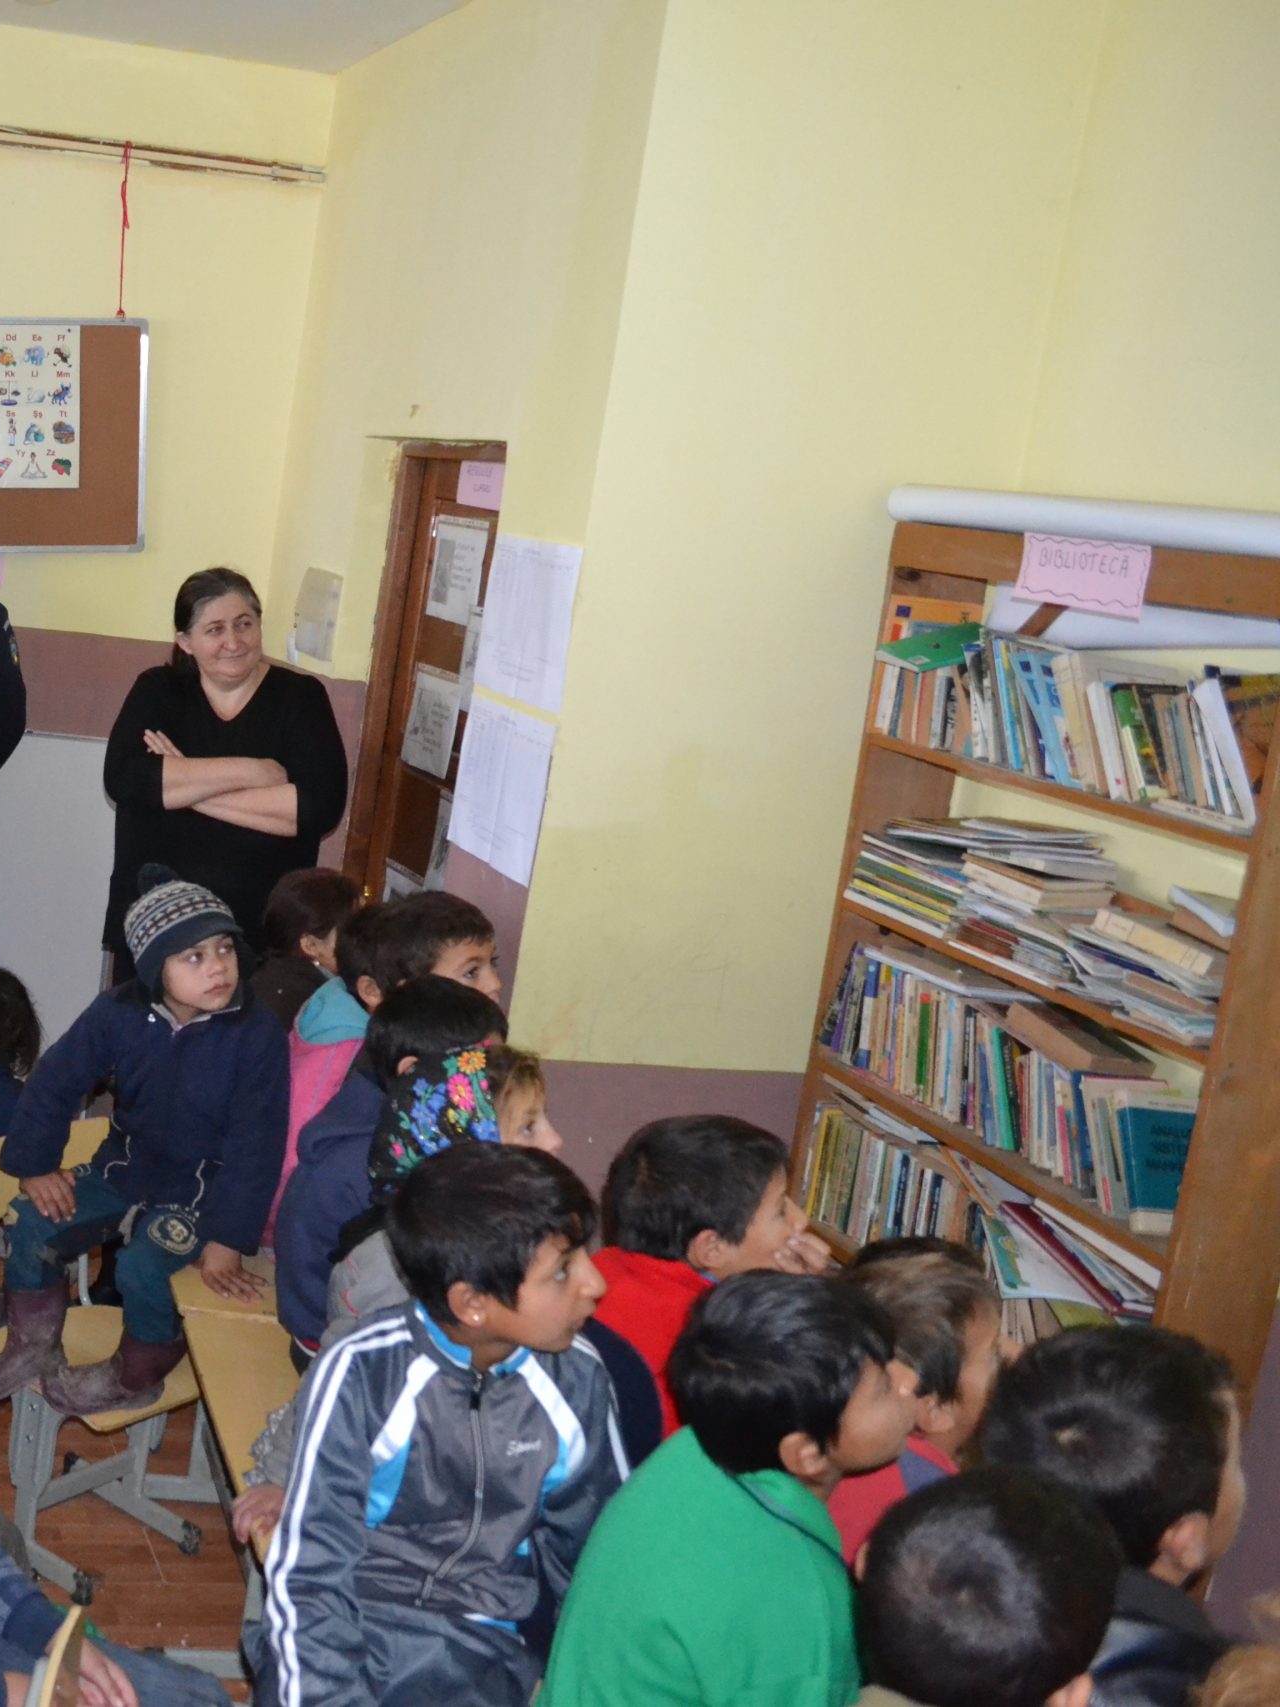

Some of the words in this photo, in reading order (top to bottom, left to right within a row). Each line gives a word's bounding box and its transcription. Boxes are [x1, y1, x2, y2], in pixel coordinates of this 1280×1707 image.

[5, 334, 17, 342] Dd
[32, 334, 42, 342] Ee
[57, 334, 66, 342] Ff
[5, 370, 16, 378] Kk
[16, 449, 26, 458] Yy
[46, 448, 56, 456] Zz
